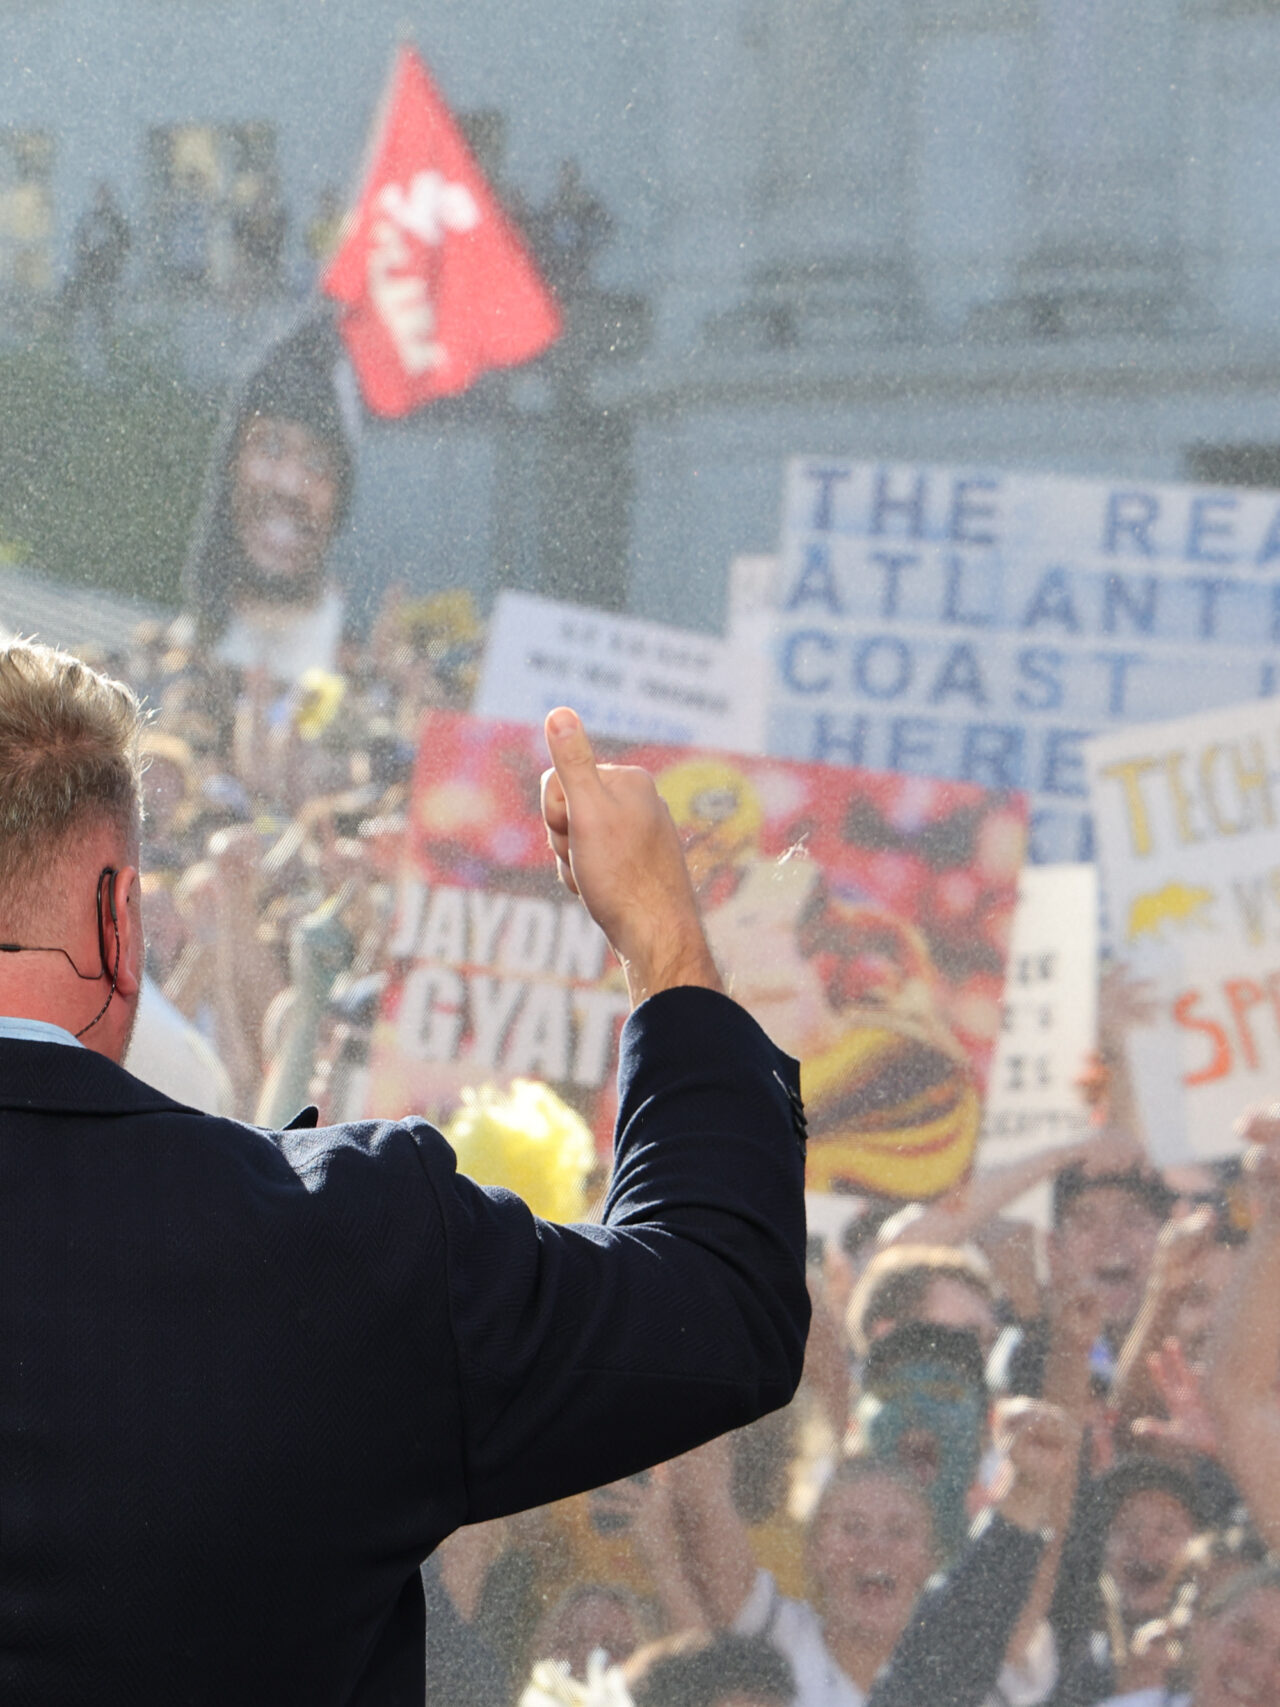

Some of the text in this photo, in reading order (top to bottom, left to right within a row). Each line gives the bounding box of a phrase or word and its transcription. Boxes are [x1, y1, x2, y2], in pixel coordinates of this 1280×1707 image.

[803, 466, 999, 547] THE
[778, 626, 1146, 717] COAST
[812, 711, 1094, 801] HERE
